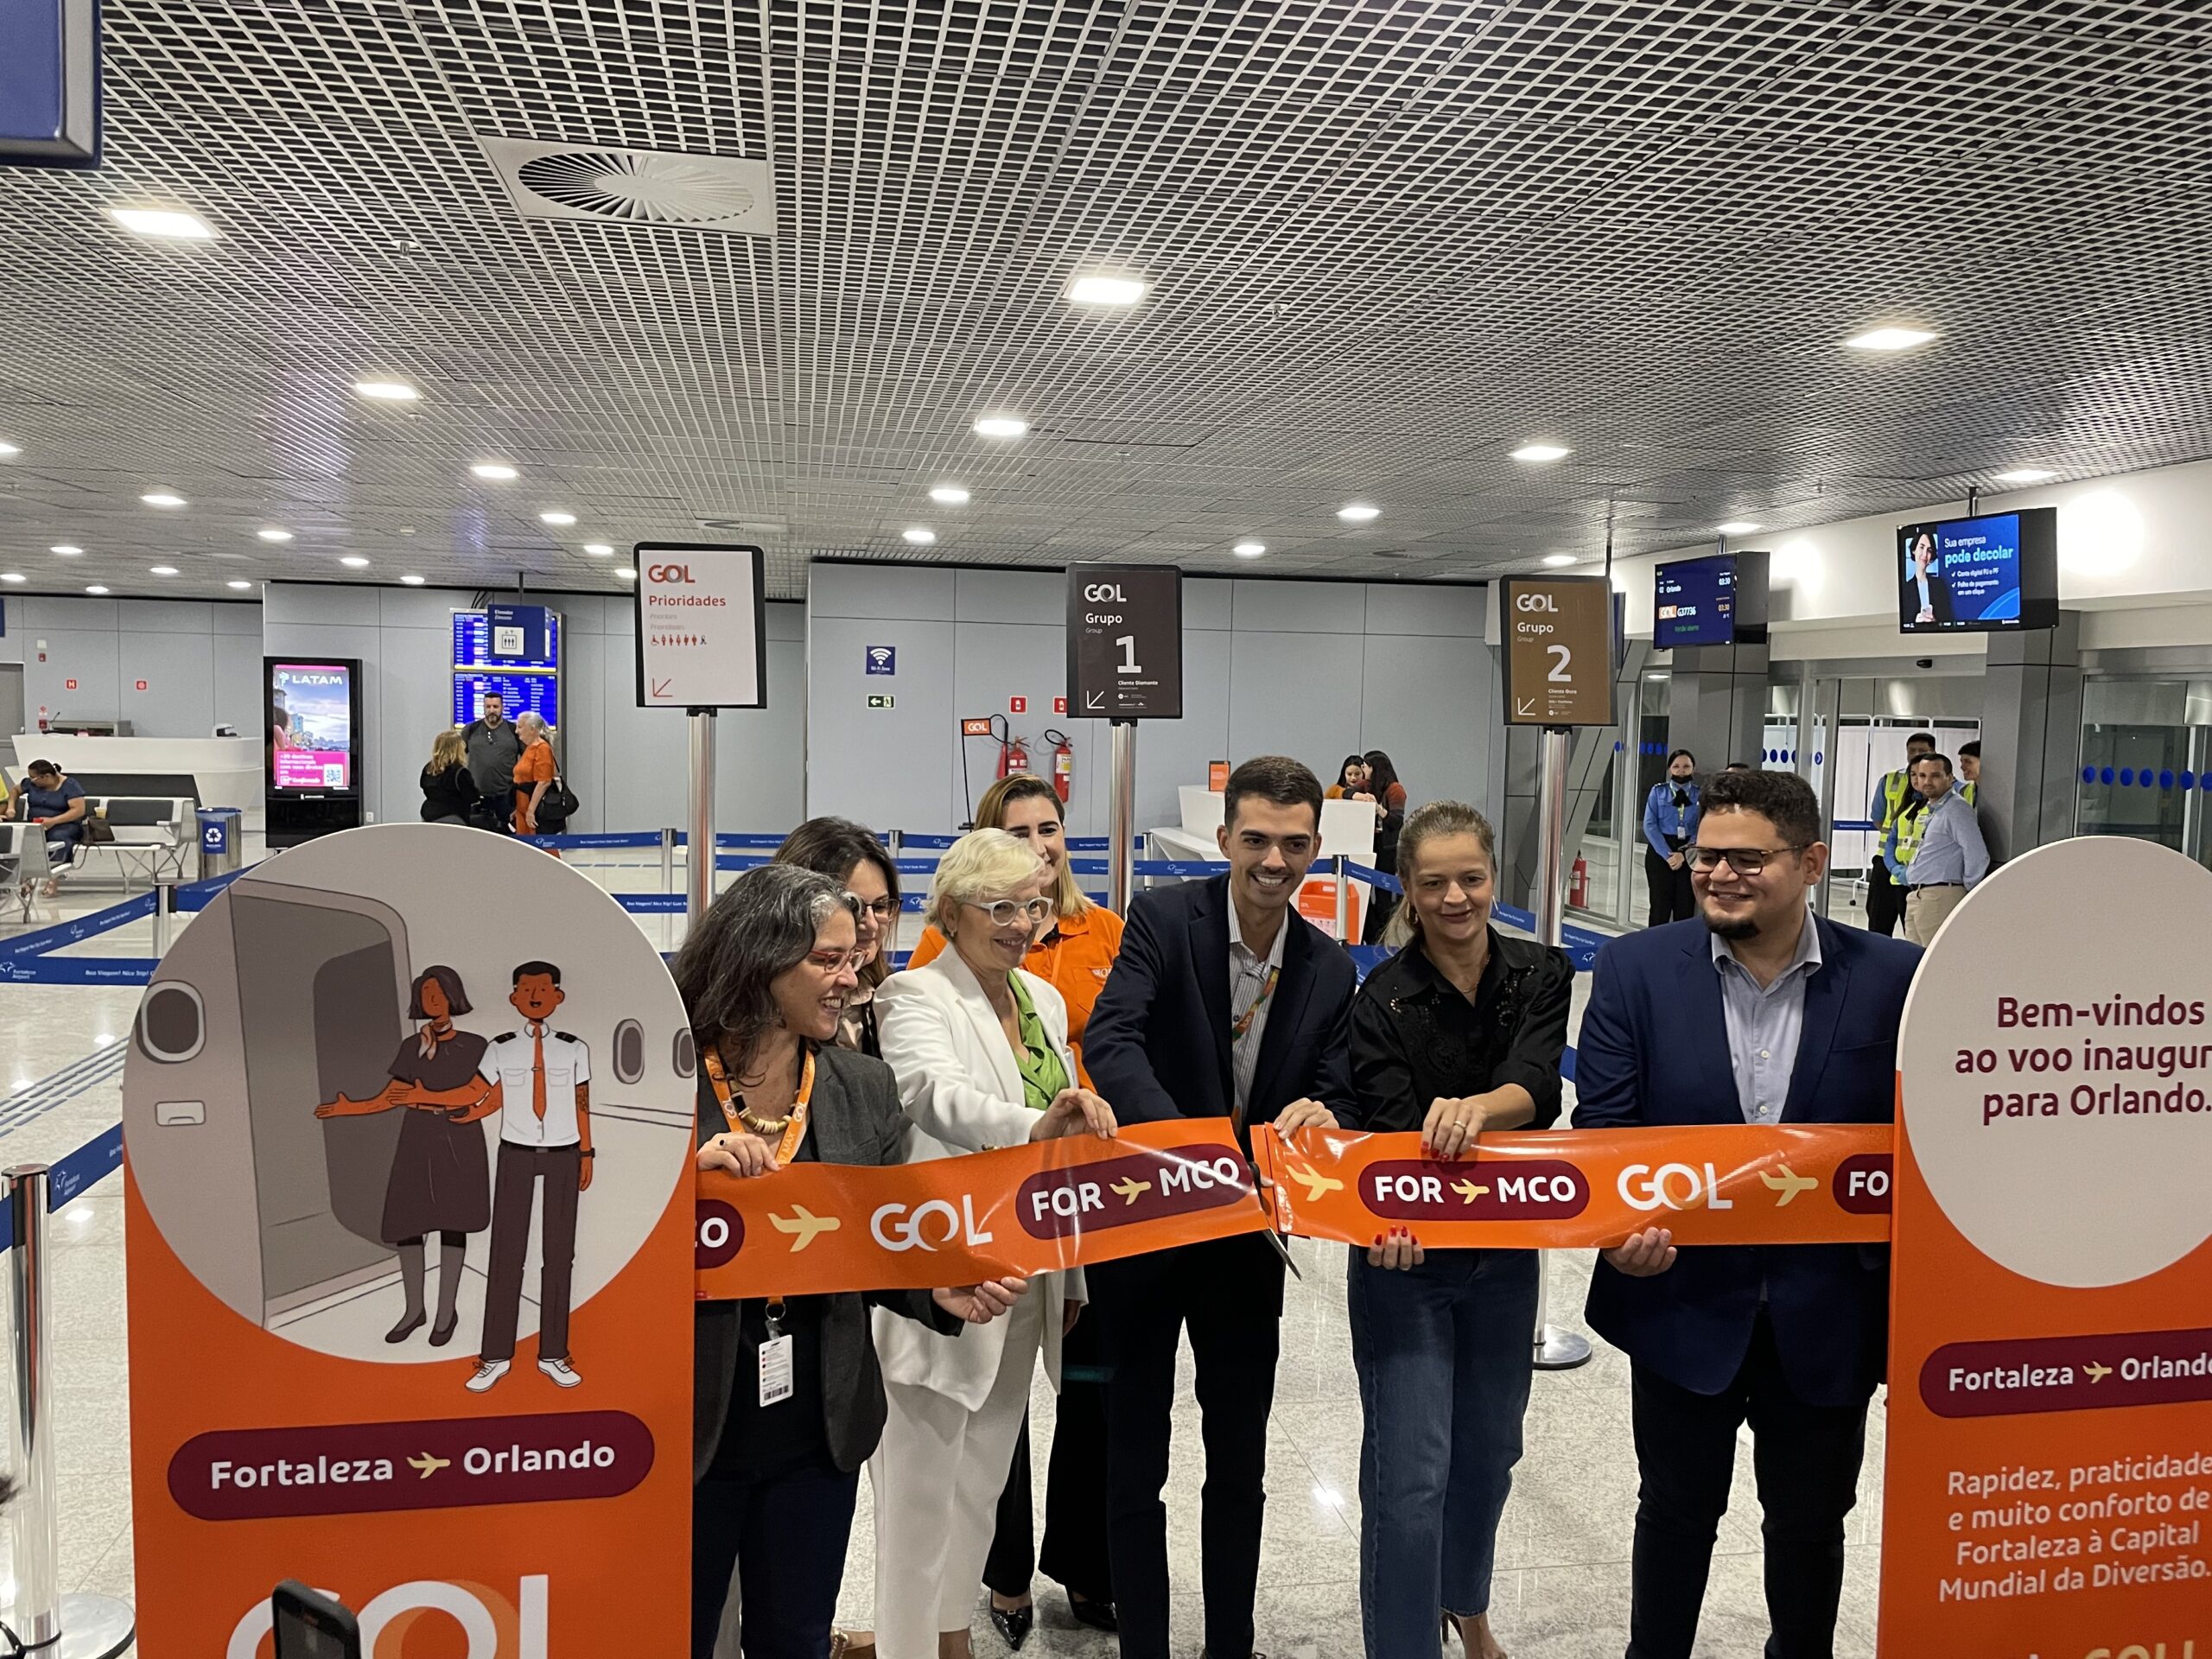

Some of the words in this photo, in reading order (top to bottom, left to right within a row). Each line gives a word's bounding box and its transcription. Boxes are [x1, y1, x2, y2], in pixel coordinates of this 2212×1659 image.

[1944, 537, 1958, 549] Sua
[1958, 536, 1986, 548] empresa
[1944, 550, 1971, 569] pode
[1973, 544, 2014, 563] decolar
[648, 564, 696, 583] GOL
[648, 594, 727, 607] Prioridades
[1084, 583, 1128, 603] GOL
[1516, 594, 1559, 613] GOL
[1085, 613, 1123, 626] Grupo
[1516, 622, 1554, 635] Grupo
[1116, 635, 1142, 674] 1
[1547, 644, 1572, 683] 2
[291, 675, 343, 685] LATAM
[967, 722, 988, 732] GOL
[1997, 993, 2206, 1028] Bem-vindos
[1955, 1048, 1997, 1074] ao
[2008, 1046, 2073, 1072] voo
[1982, 1090, 2060, 1127] para
[2070, 1081, 2212, 1116] Orlando.
[1030, 1181, 1106, 1222] FOR
[1158, 1156, 1242, 1198] MCO
[1375, 1175, 1445, 1204] FOR
[1497, 1175, 1577, 1204] MCO
[1617, 1161, 1733, 1211] GOL
[870, 1193, 994, 1252] GOL
[1948, 1363, 2075, 1392] Fortaleza
[210, 1455, 395, 1491] Fortaleza
[462, 1440, 616, 1476] Orlando
[1947, 1465, 2063, 1499] Rapidez,
[2069, 1451, 2212, 1492] praticidade
[1948, 1511, 1965, 1531] e
[1971, 1500, 2052, 1530] muito
[2057, 1492, 2173, 1522] conforto
[2178, 1486, 2212, 1510] de
[1955, 1535, 2081, 1566] Fortaleza
[2087, 1528, 2103, 1554] à
[2109, 1520, 2201, 1554] Capital
[1938, 1569, 2047, 1603] Mundial
[2052, 1566, 2085, 1592] da
[2092, 1554, 2212, 1588] Diversão.
